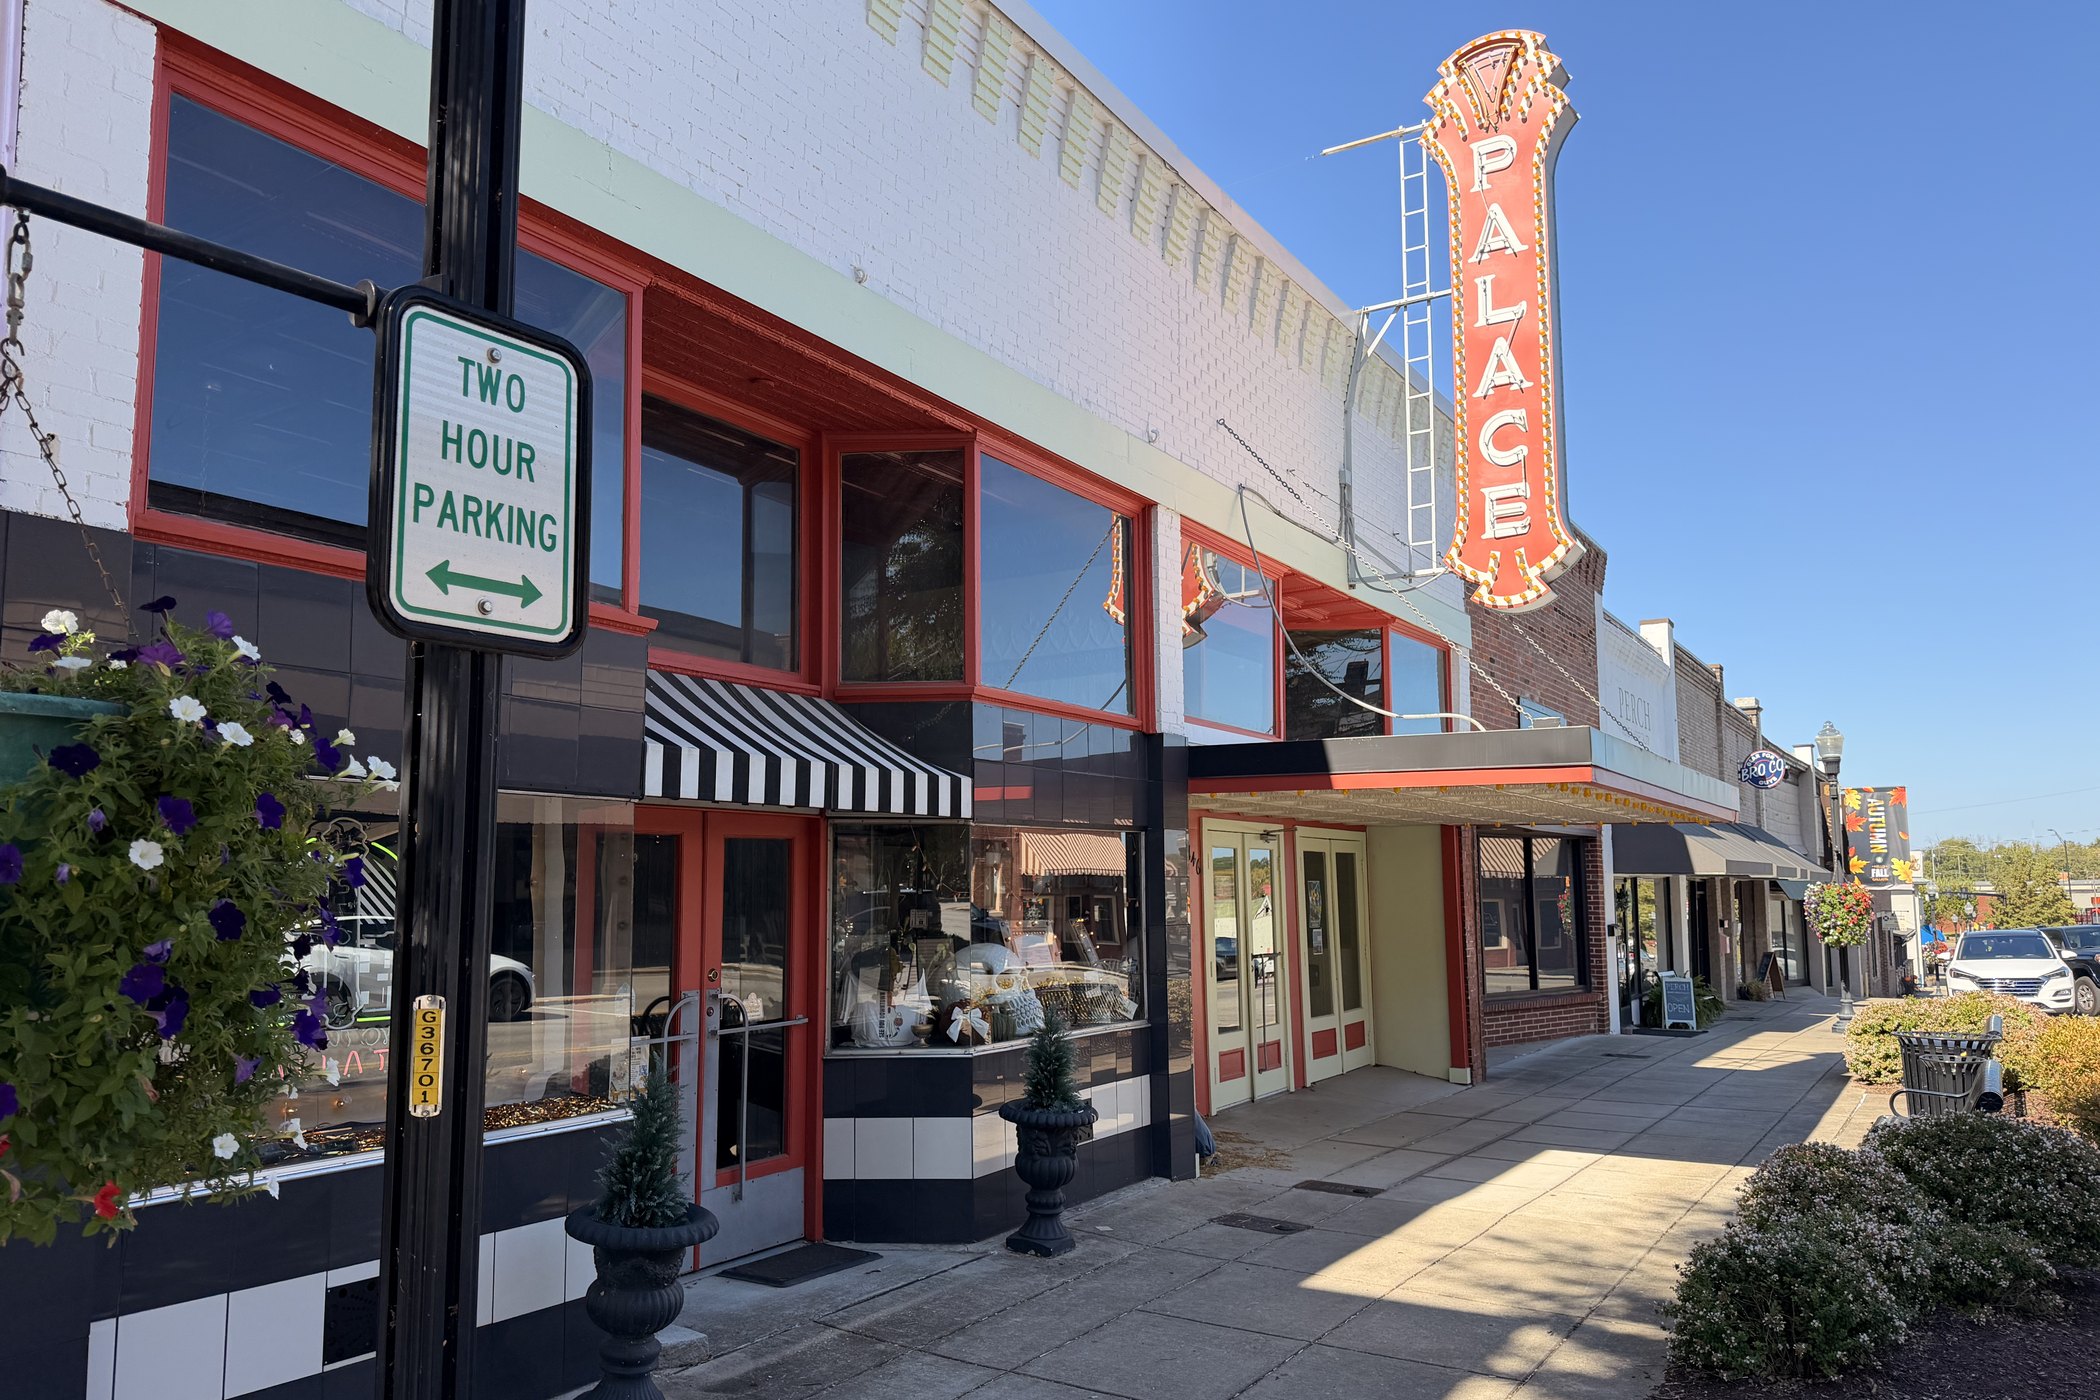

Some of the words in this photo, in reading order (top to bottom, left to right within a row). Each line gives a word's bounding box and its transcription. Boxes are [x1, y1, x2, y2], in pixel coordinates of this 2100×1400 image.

[1468, 133, 1535, 541] PALACE
[457, 355, 526, 414] TWO
[441, 419, 536, 483] HOUR
[412, 482, 557, 553] PARKING
[1618, 687, 1651, 731] PERCH
[1741, 763, 1766, 781] BRO
[1867, 798, 1888, 853] AUTUMN
[1871, 868, 1890, 878] FALL
[1666, 983, 1690, 991] PERCH
[1667, 1003, 1690, 1013] OPEN
[418, 1011, 436, 1103] G36701
